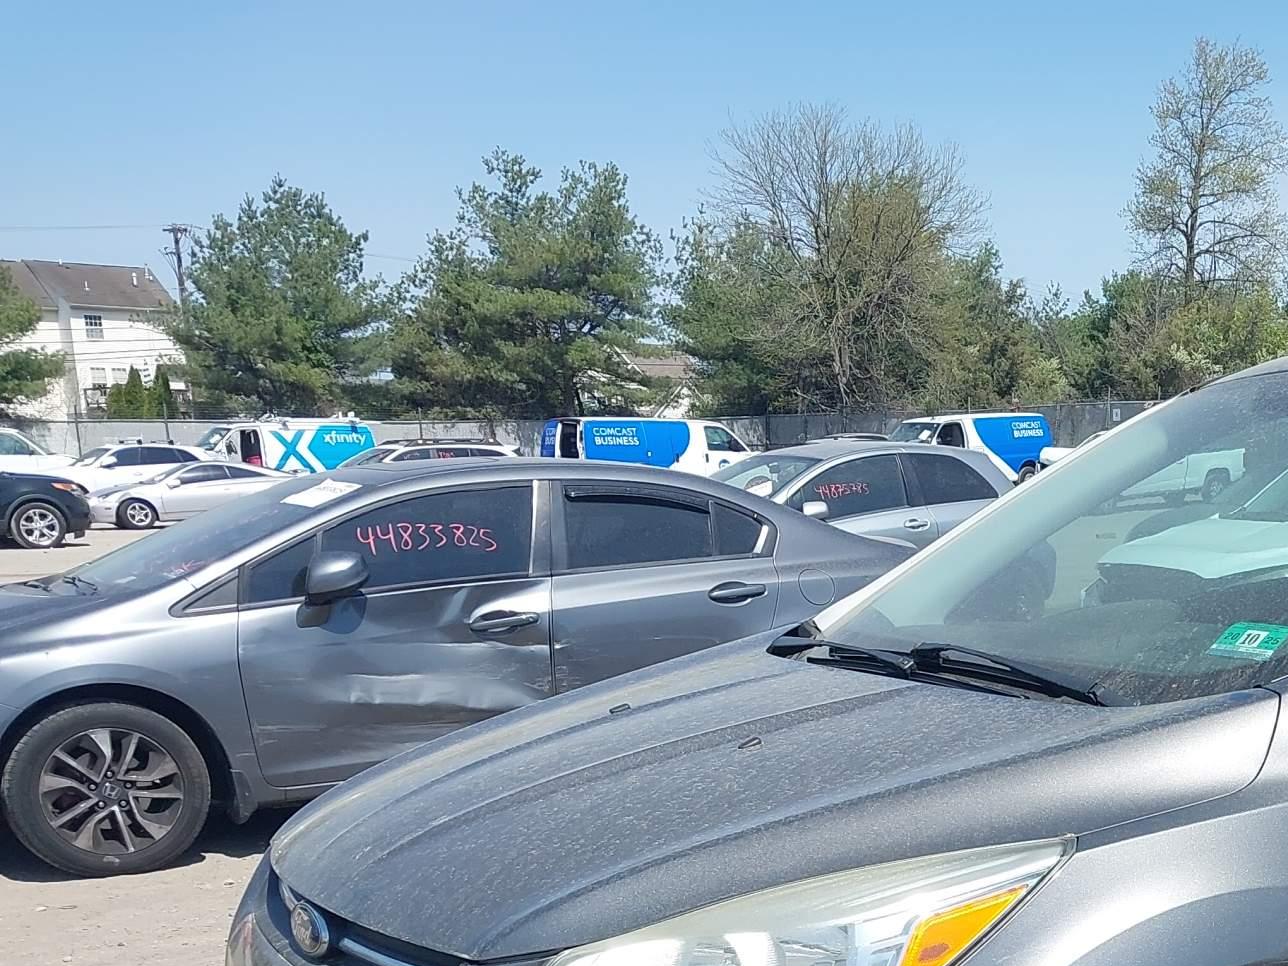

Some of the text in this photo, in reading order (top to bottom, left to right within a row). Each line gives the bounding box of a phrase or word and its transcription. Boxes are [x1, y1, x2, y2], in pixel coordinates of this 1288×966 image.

[1011, 421, 1041, 429] COMCAST
[593, 427, 637, 436] COMCAST
[1014, 429, 1044, 438] BUSINESS
[323, 431, 366, 446] xfinity
[595, 436, 640, 446] BUSINESS
[814, 482, 869, 500] 44875785
[357, 522, 497, 556] 44833825
[1224, 631, 1280, 645] 20 10 25
